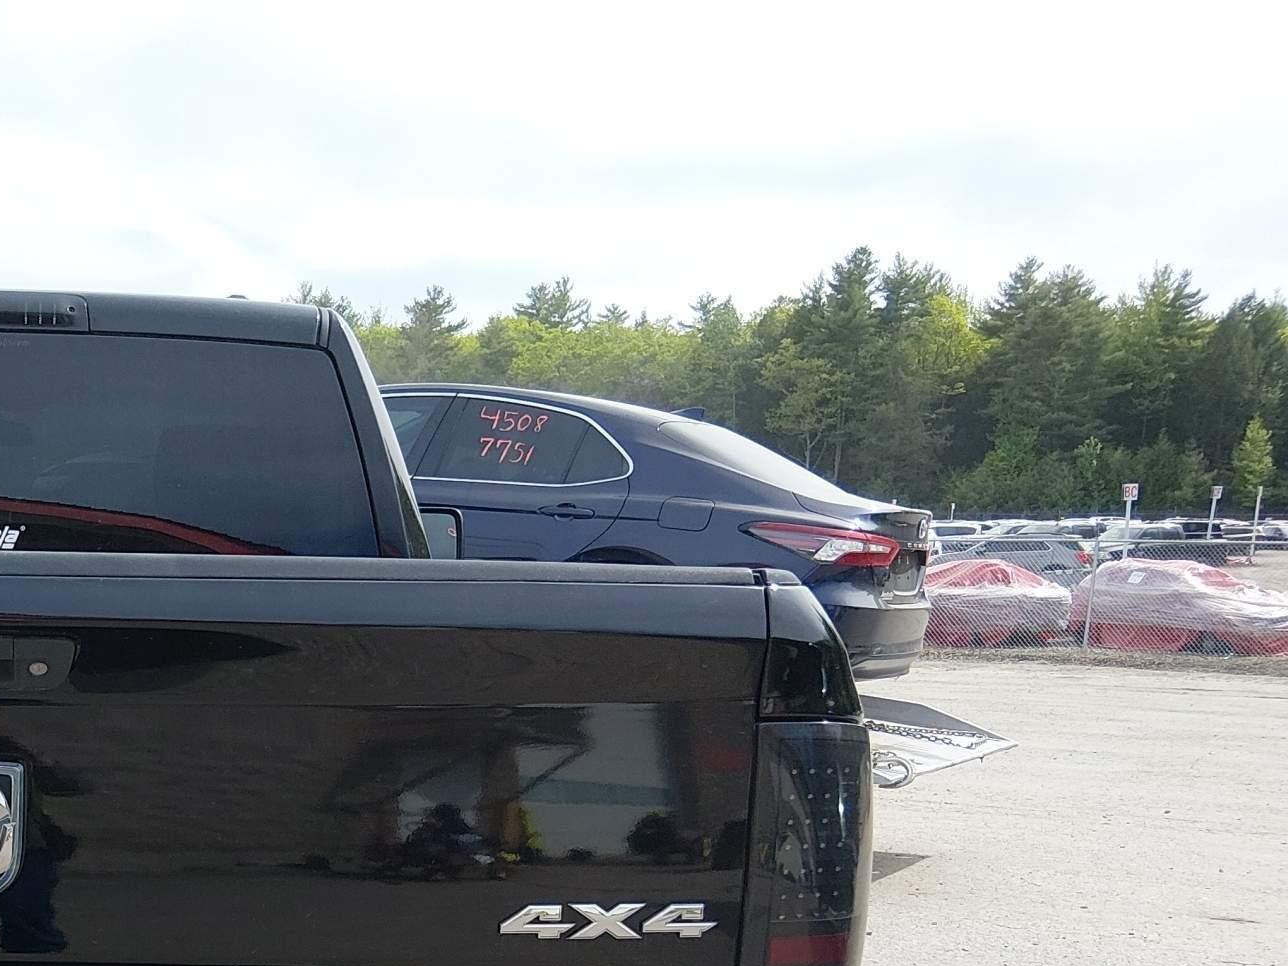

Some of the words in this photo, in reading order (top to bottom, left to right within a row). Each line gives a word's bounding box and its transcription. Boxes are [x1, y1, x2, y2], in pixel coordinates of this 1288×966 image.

[480, 405, 549, 432] 4508
[480, 437, 535, 465] 7751
[1124, 486, 1137, 498] BC
